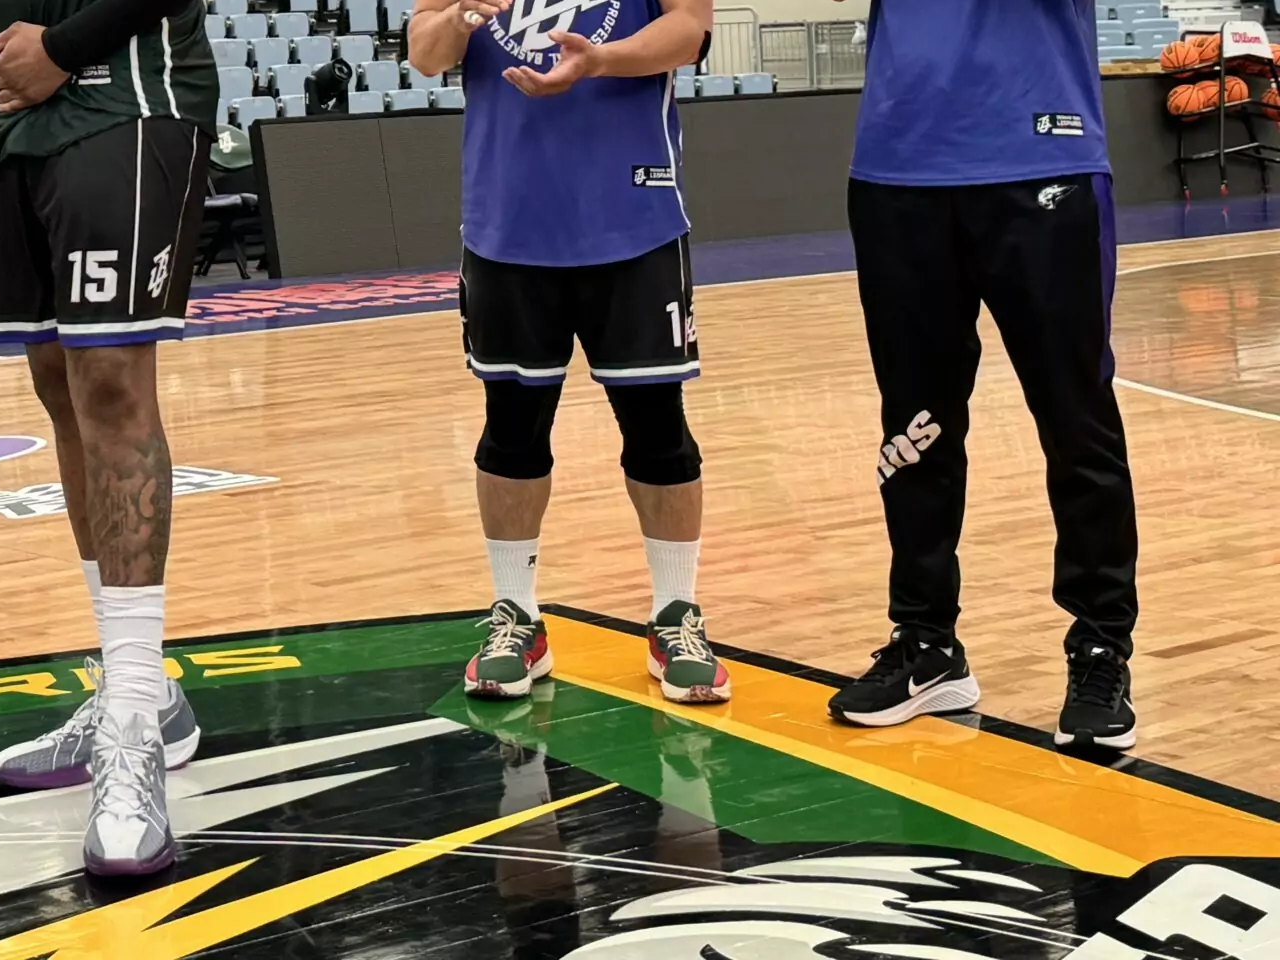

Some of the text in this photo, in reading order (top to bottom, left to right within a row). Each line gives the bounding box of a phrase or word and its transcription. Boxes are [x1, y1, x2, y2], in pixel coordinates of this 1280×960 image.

[487, 15, 543, 65] BASKETBAL
[1231, 31, 1263, 44] Wilson
[68, 250, 119, 303] 15
